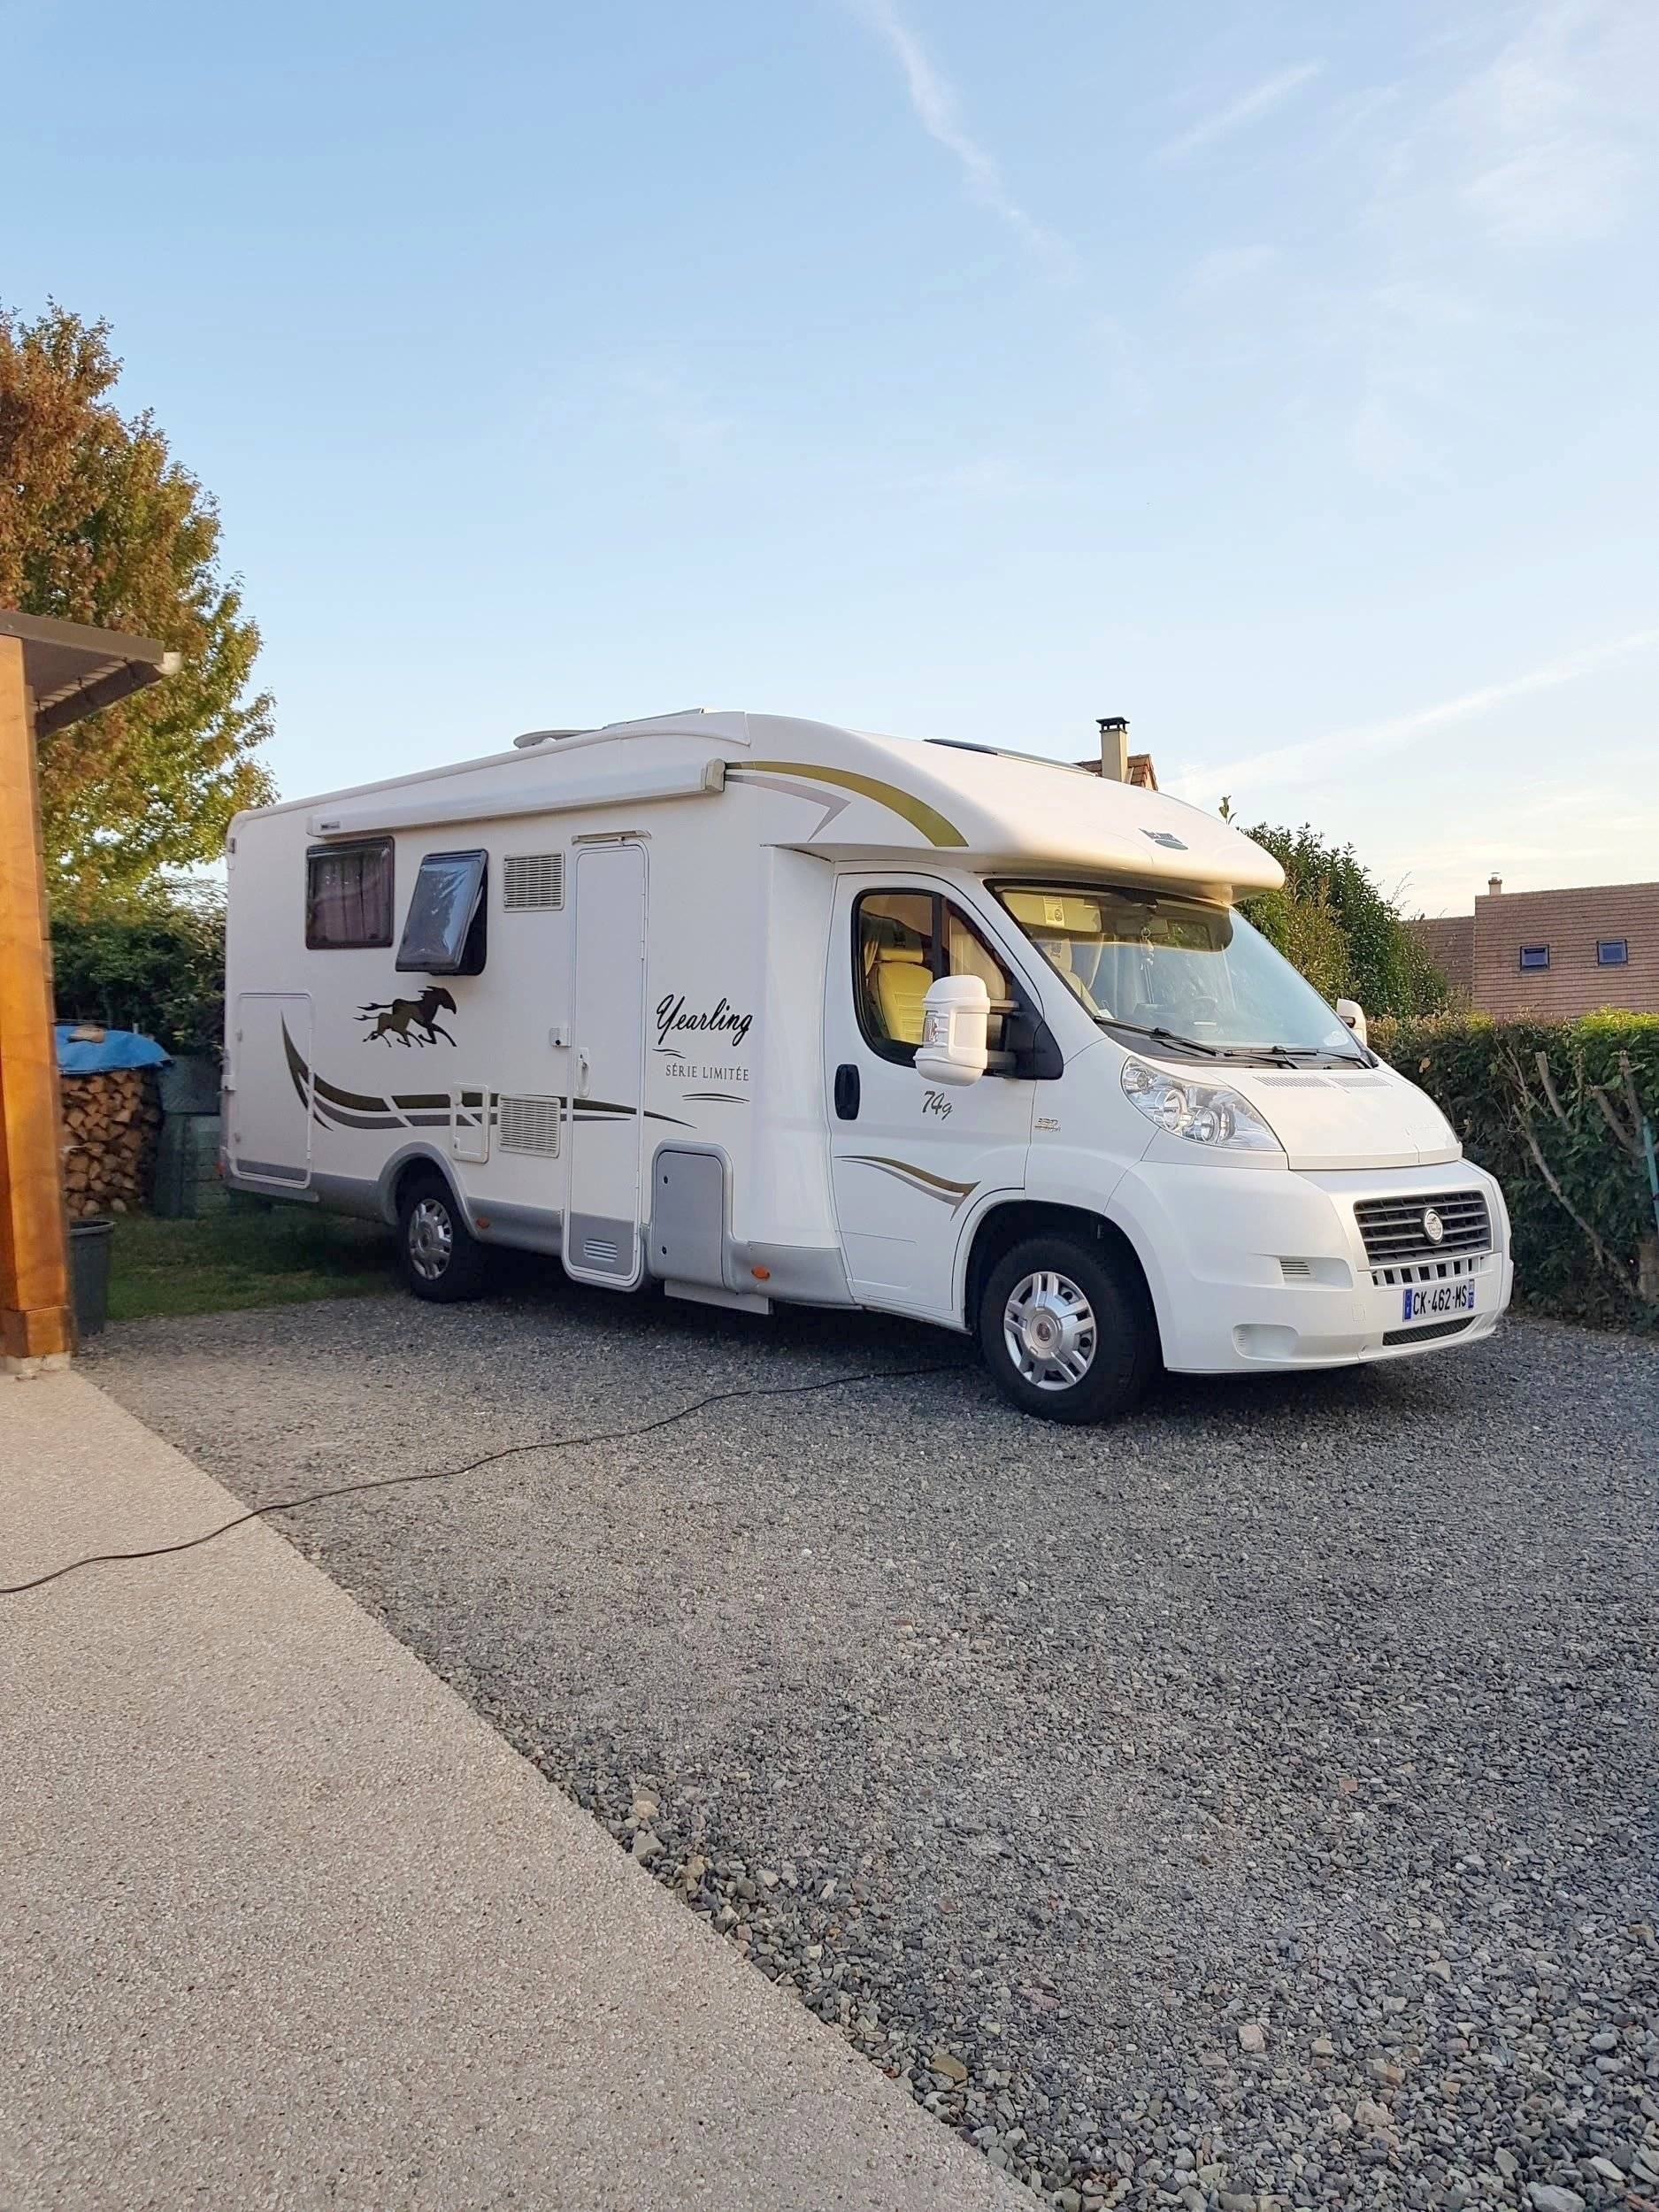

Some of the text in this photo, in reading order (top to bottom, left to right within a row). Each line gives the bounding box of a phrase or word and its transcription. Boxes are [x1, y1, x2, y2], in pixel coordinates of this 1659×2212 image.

[656, 994, 753, 1047] Yearling
[665, 1063, 749, 1081] SÉRIE LIMITÉE
[922, 1090, 953, 1120] 74g
